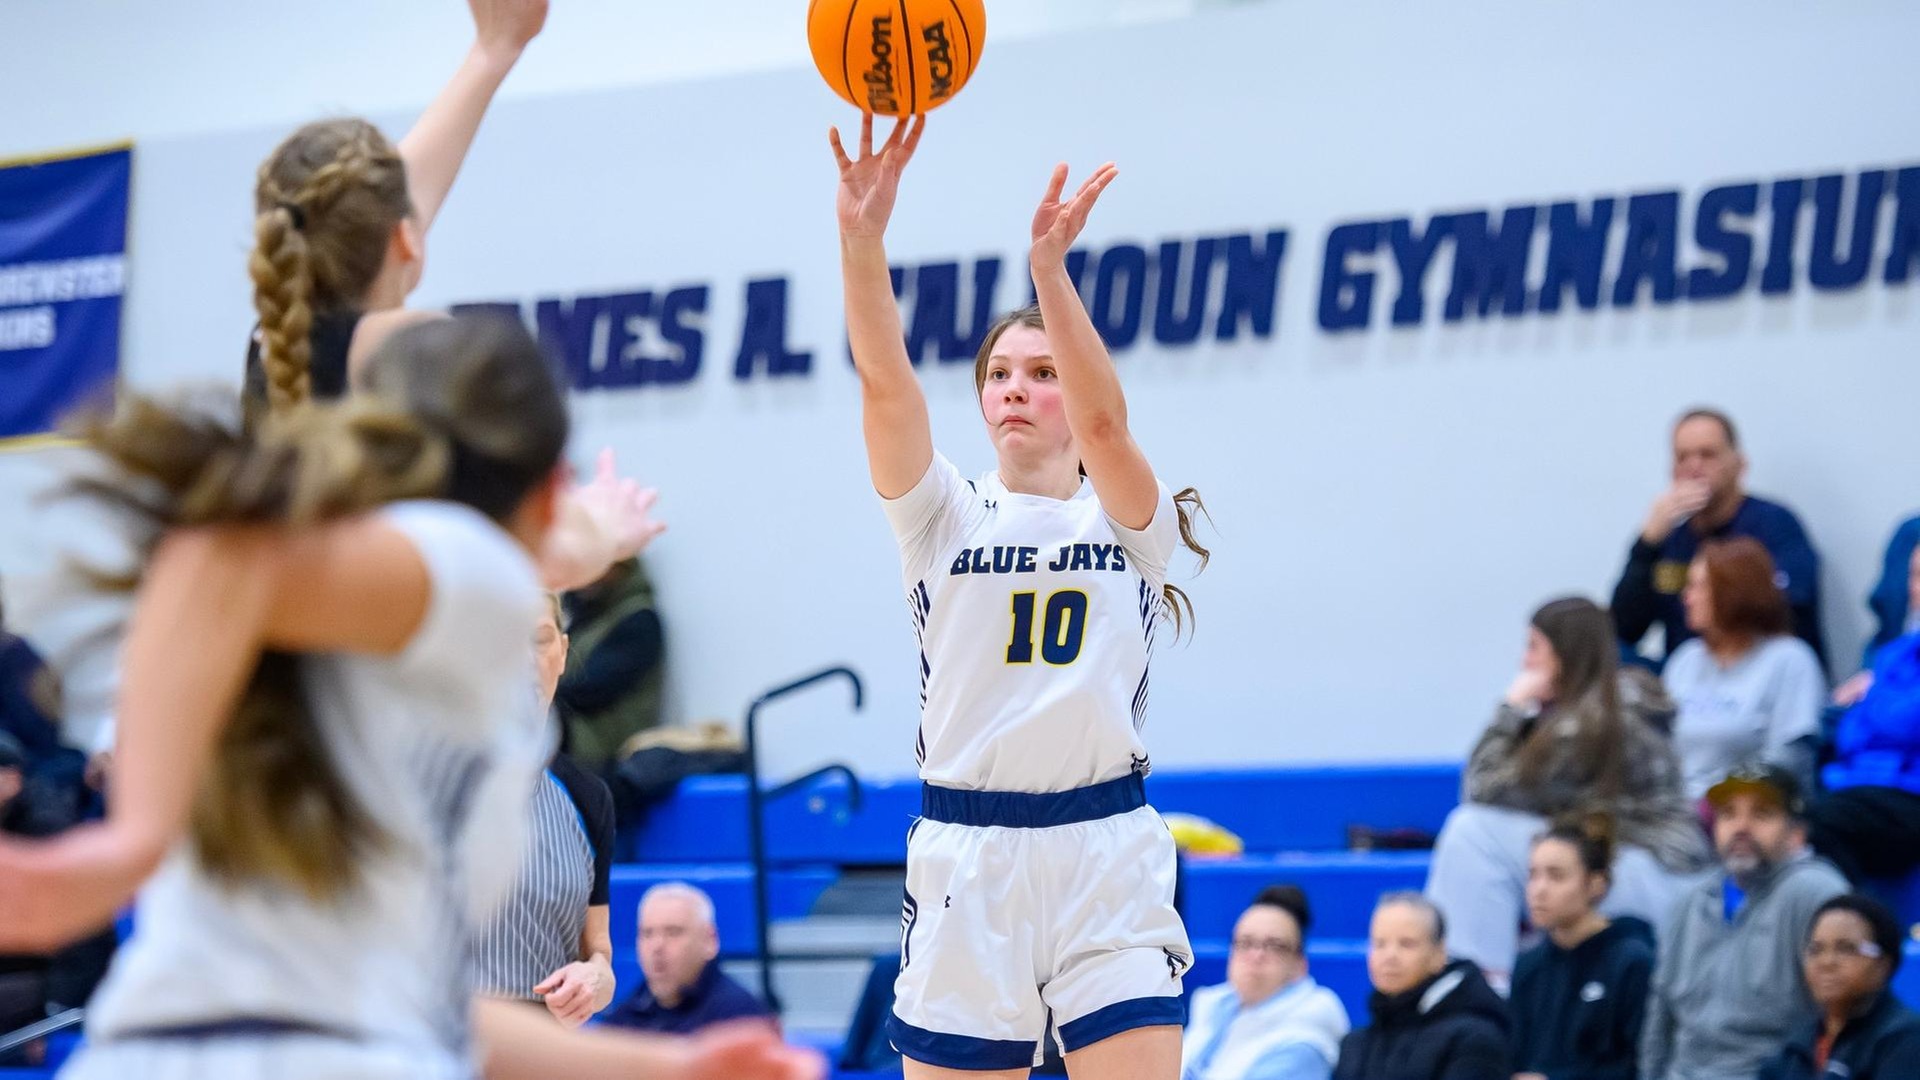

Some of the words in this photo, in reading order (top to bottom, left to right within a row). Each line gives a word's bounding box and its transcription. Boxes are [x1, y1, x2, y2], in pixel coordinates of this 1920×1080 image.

[922, 20, 953, 101] NCAA
[450, 284, 709, 388] MES
[848, 228, 1287, 369] ALOUN
[950, 546, 1038, 575] BLUE
[1048, 543, 1126, 571] JAYS
[1005, 589, 1088, 667] 10
